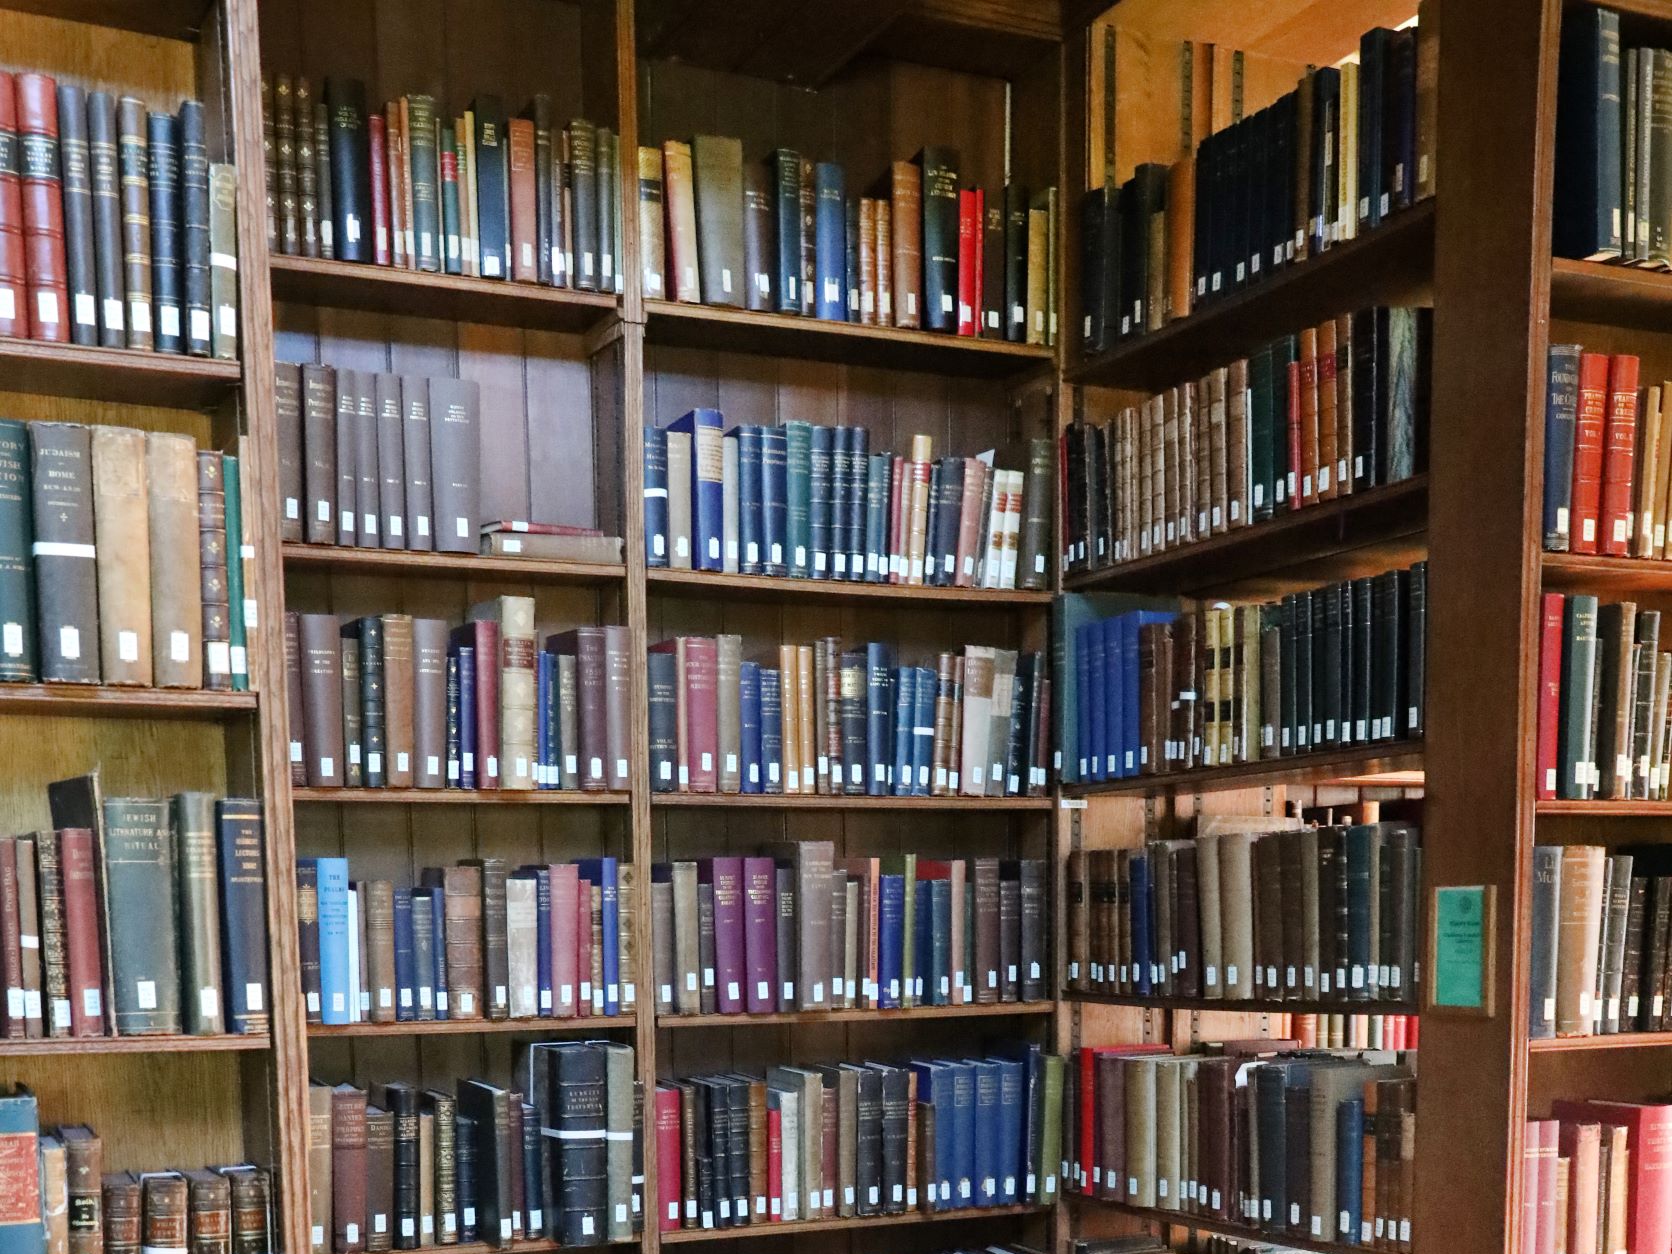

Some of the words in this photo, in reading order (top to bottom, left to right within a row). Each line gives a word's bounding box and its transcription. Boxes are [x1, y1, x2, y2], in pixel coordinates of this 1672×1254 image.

[40, 448, 80, 458] JUDAISM
[122, 813, 156, 823] JEWISH
[108, 828, 153, 837] LITERATURE
[124, 842, 160, 850] RITUAL
